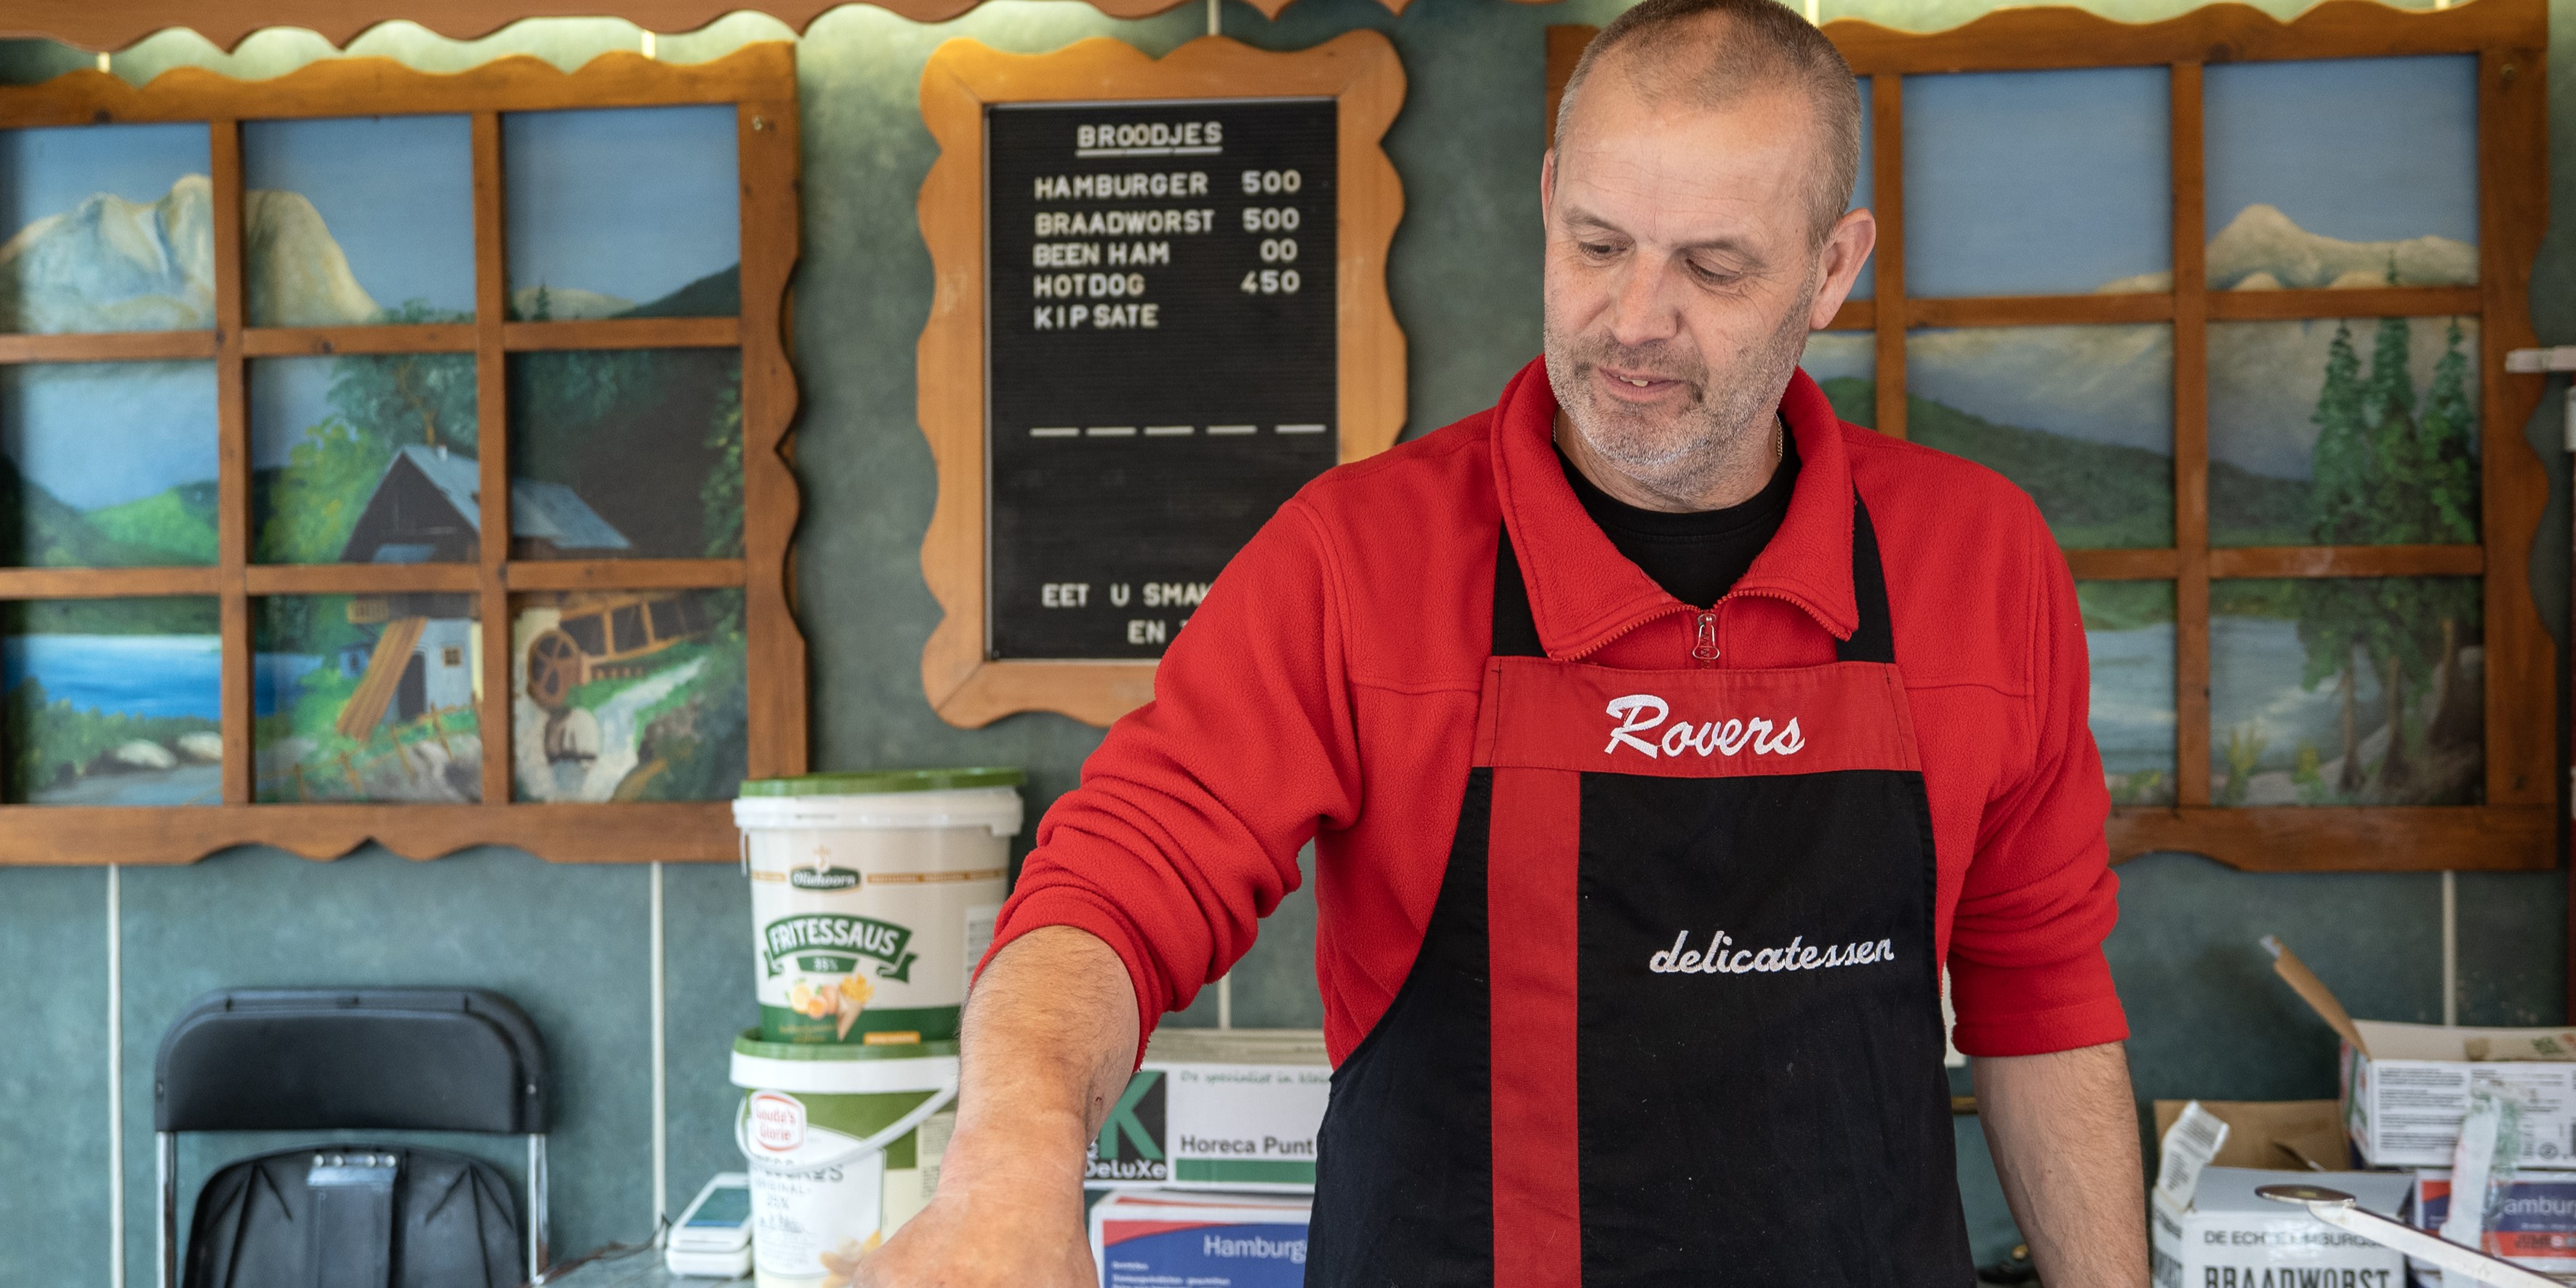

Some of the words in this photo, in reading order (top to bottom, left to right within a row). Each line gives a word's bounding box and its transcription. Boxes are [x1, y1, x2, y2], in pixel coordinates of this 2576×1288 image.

[1078, 122, 1222, 147] BROODJES
[1034, 172, 1209, 200] HAMBURGER
[1242, 170, 1301, 195] 500
[1034, 209, 1215, 237] BRAADWORST
[1242, 207, 1300, 233] 500
[1032, 243, 1100, 267] BEEN
[1108, 241, 1170, 266] HAM
[1260, 239, 1298, 263] 00
[1033, 273, 1146, 299] HOTDOG
[1240, 270, 1301, 294] 450
[1042, 583, 1090, 608] EET
[1110, 583, 1131, 606] U
[1128, 620, 1166, 644] EN
[1604, 694, 1805, 759] Rovers
[769, 917, 899, 956] FRITESSAUS
[1650, 930, 1895, 974] delicatessen
[1180, 1135, 1256, 1154] Horeca
[1263, 1137, 1314, 1156] Punt
[1203, 1235, 1307, 1263] Hamburg
[2204, 1231, 2228, 1244] DE
